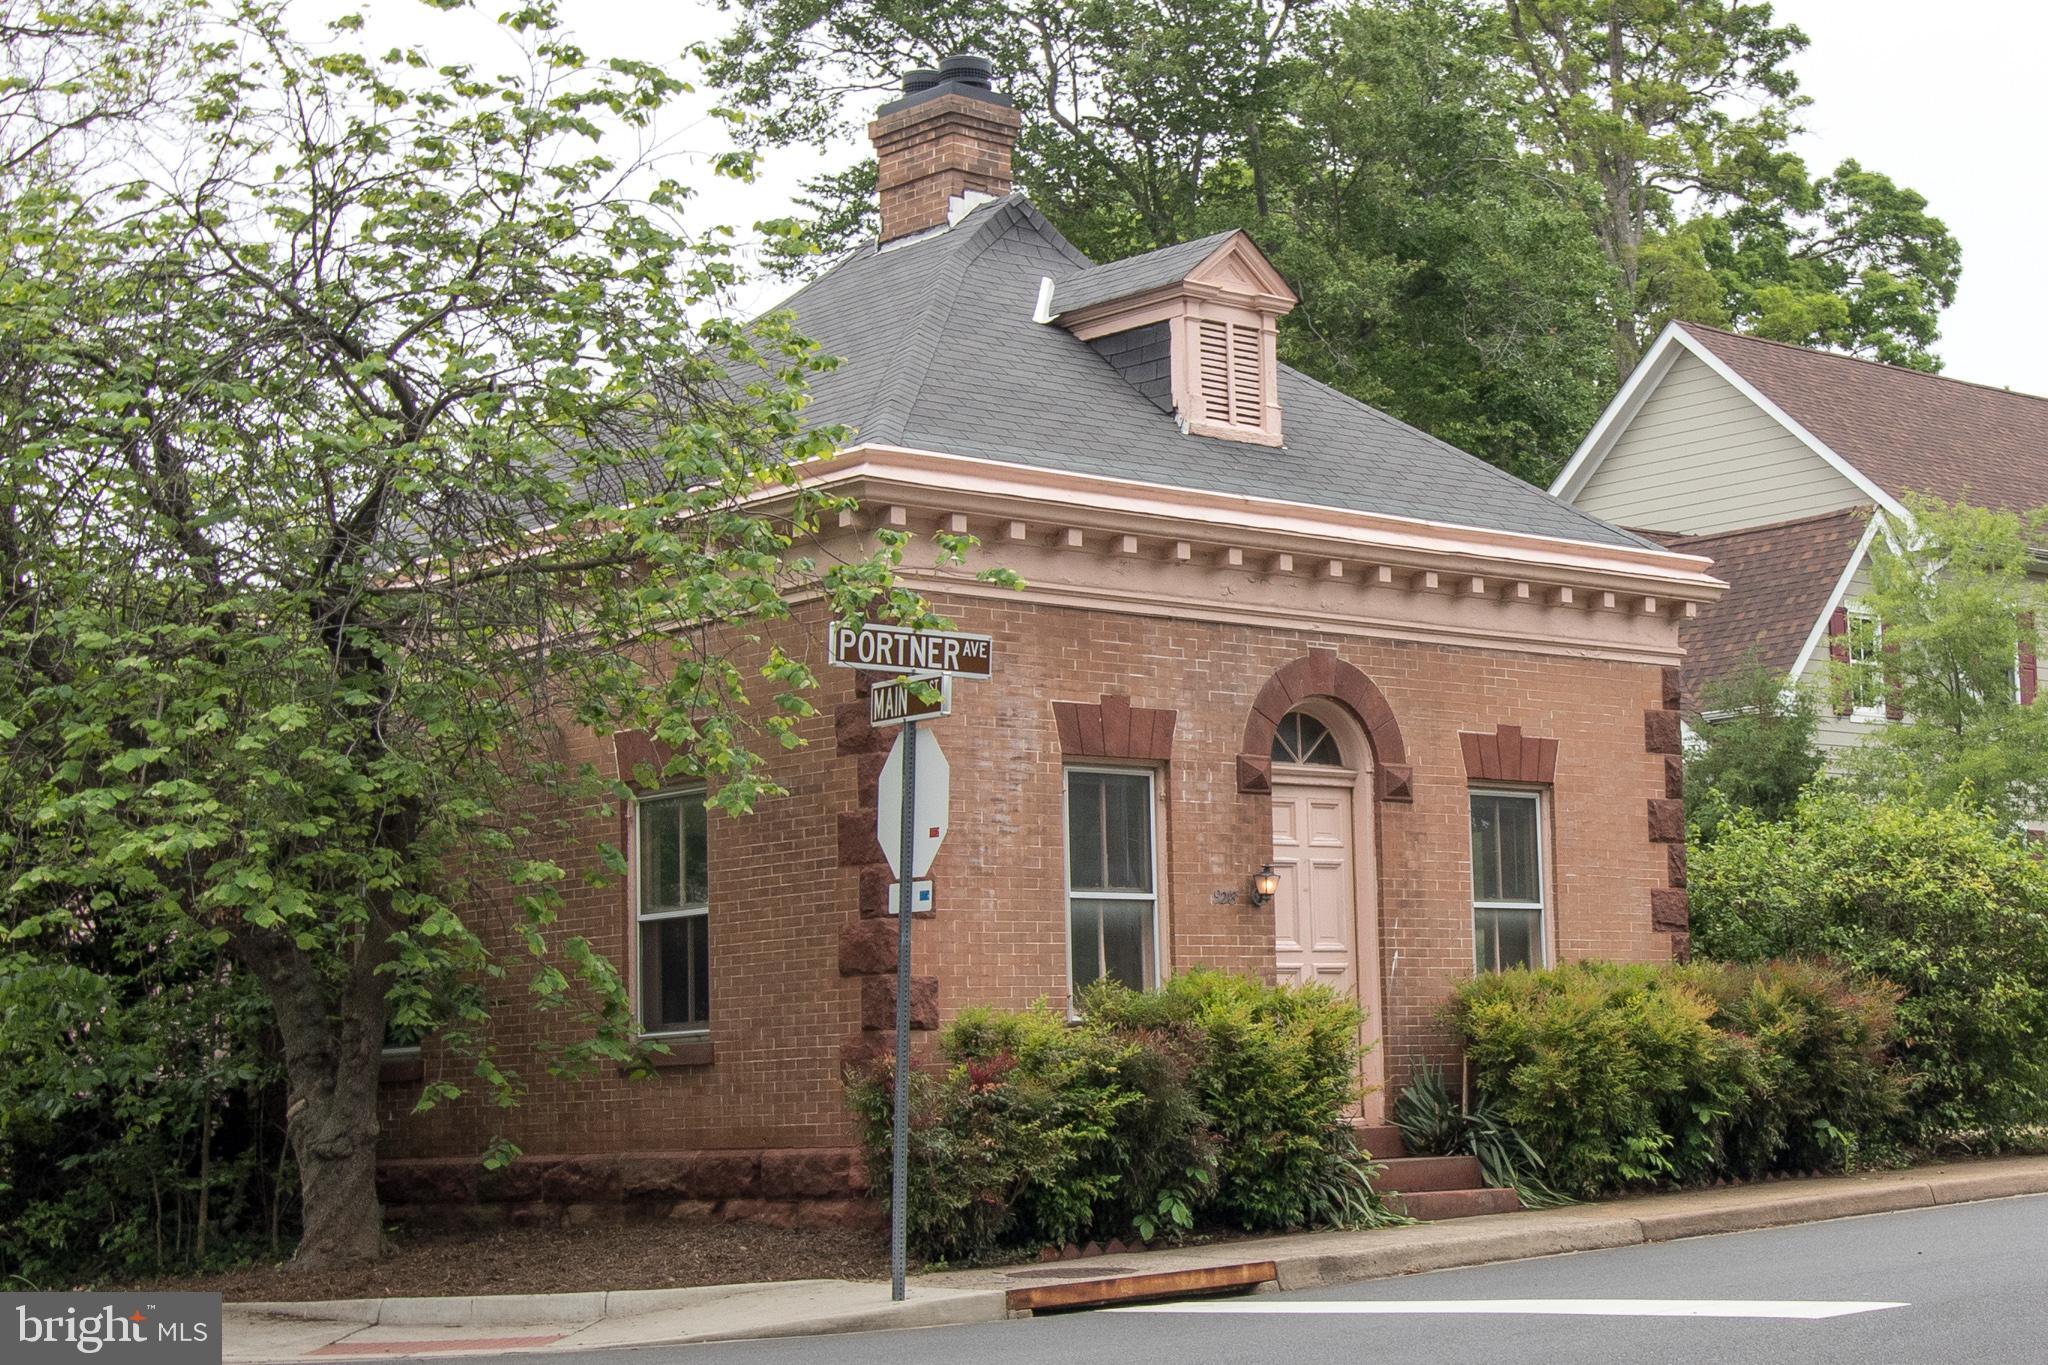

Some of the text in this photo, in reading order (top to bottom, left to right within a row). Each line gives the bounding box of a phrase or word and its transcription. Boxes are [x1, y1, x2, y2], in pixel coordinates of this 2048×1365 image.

[839, 629, 988, 670] PORTNER AVE
[873, 685, 908, 721] MAIN
